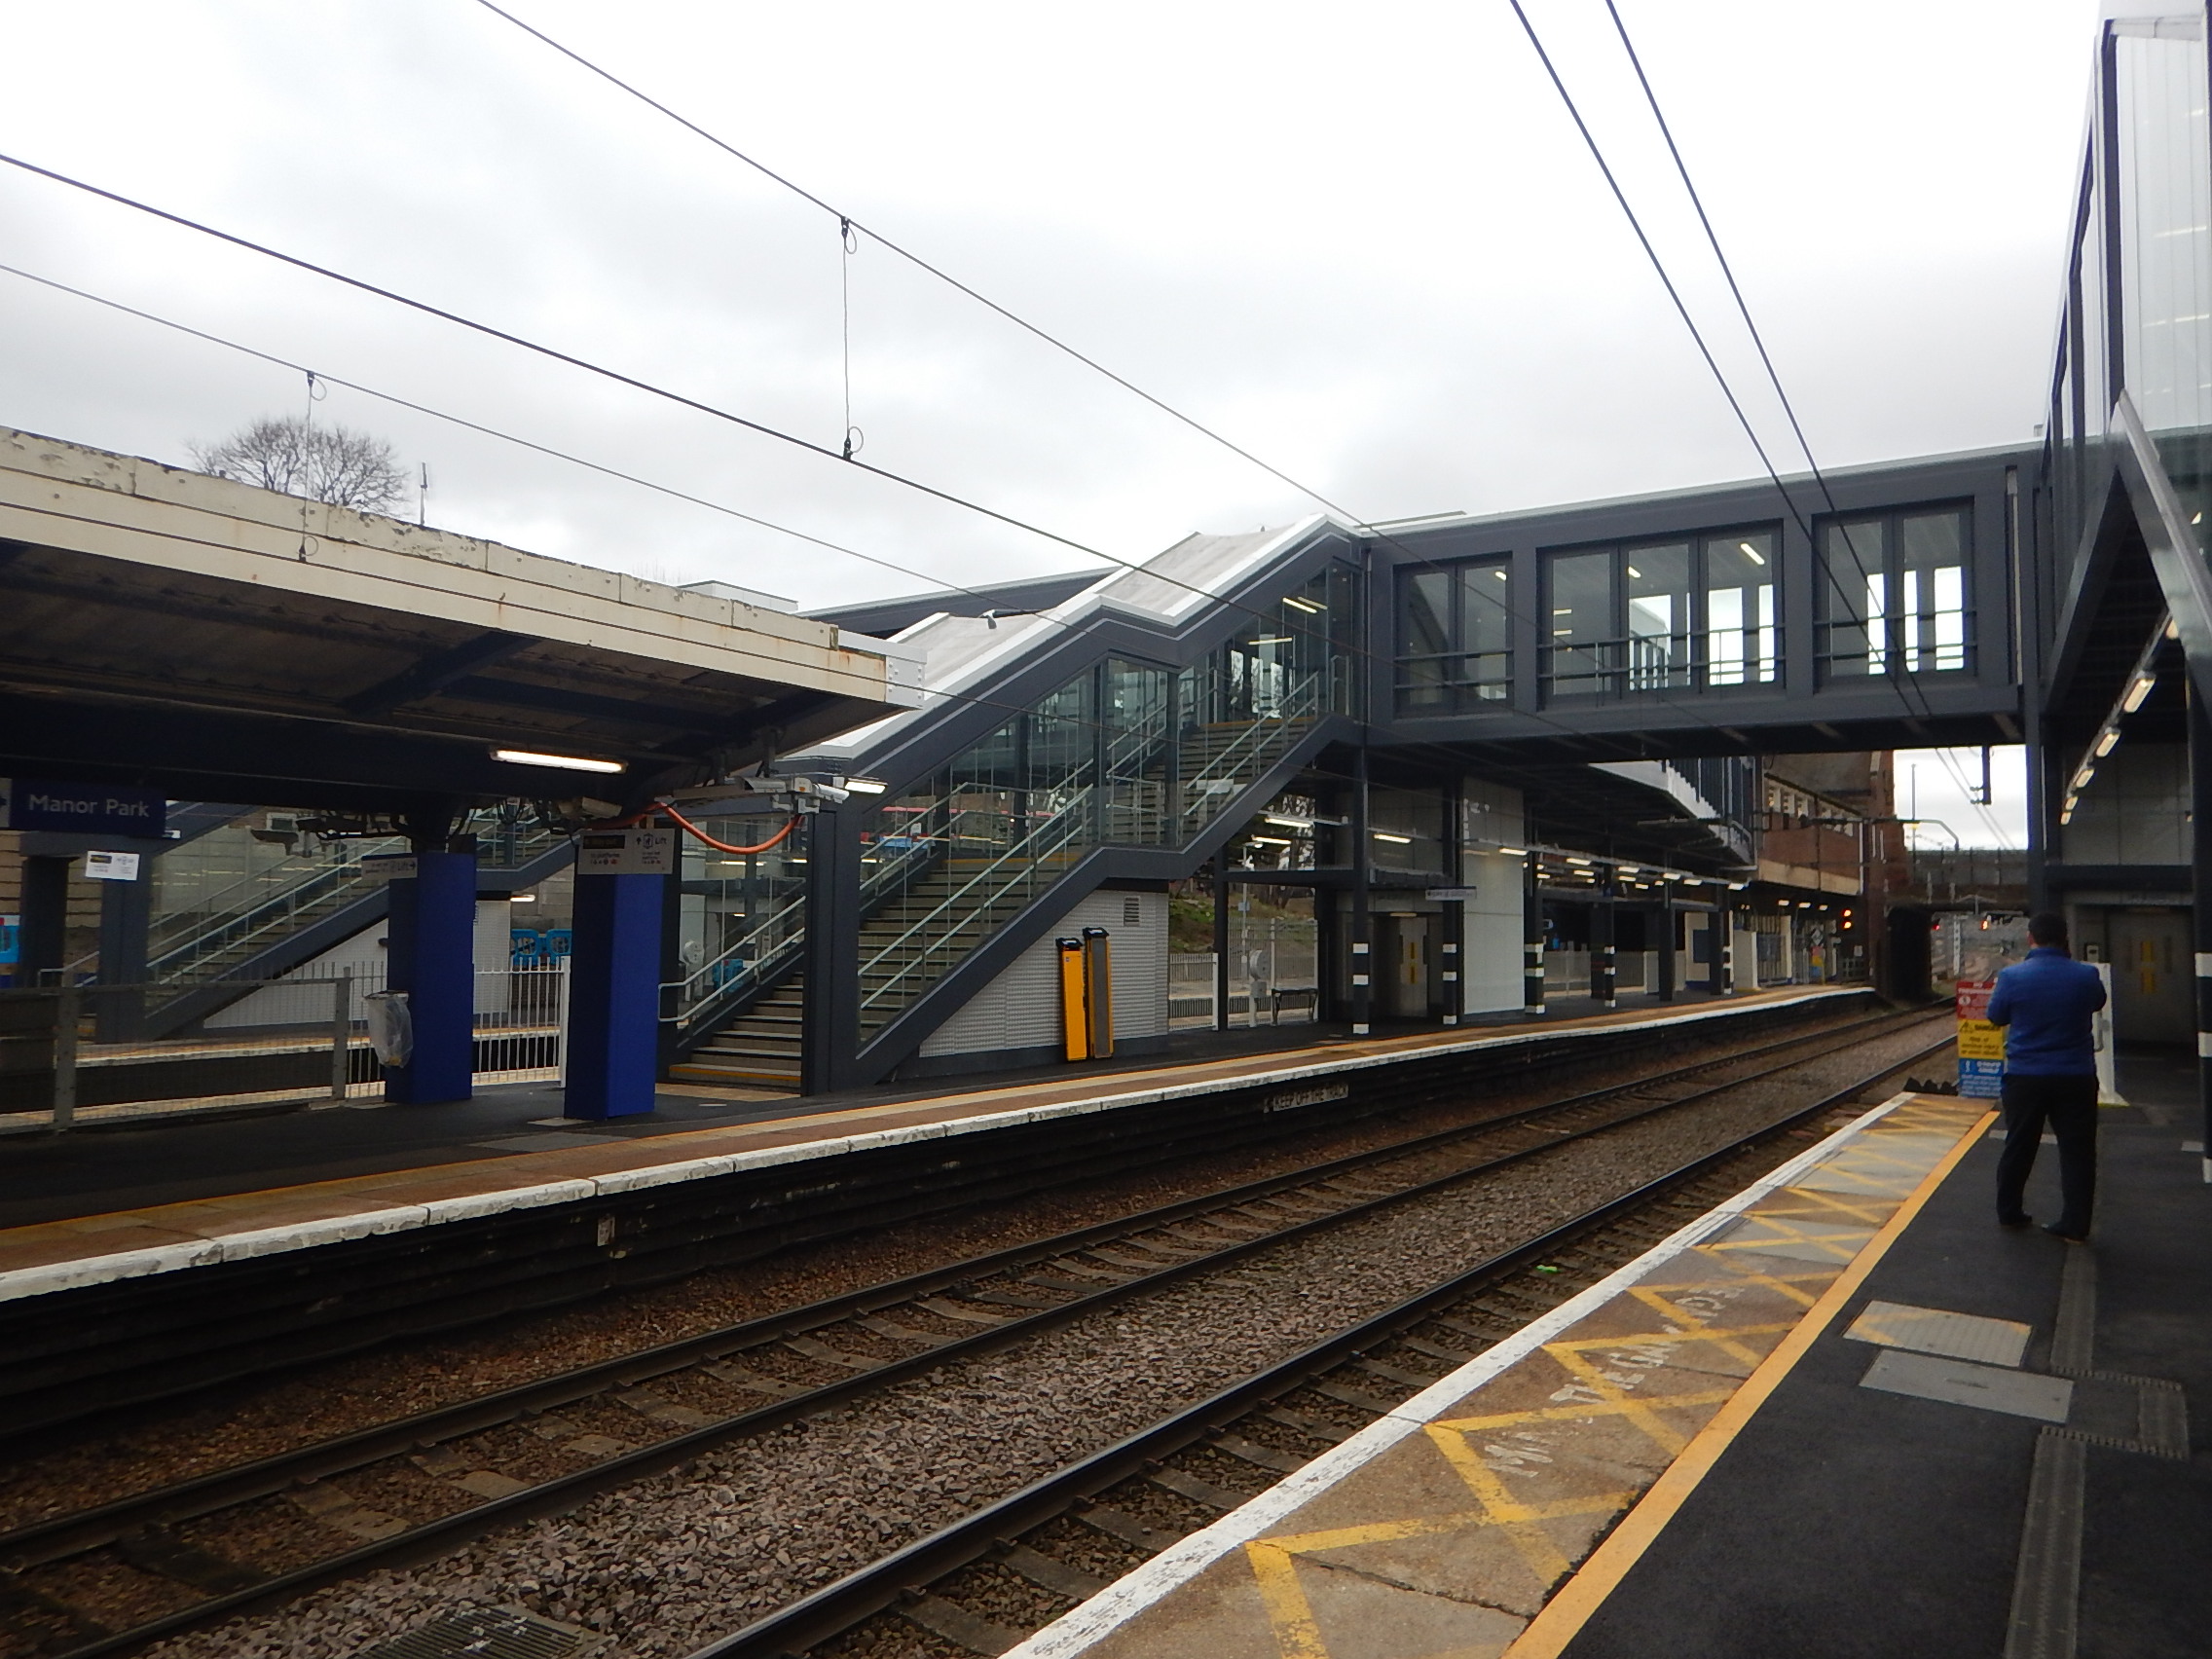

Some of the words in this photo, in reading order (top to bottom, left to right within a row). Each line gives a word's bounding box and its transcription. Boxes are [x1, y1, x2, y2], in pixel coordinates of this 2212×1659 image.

[28, 793, 98, 815] Manor
[105, 797, 150, 818] Park
[654, 836, 667, 845] Lift
[1274, 1092, 1295, 1109] KEEP
[1296, 1089, 1309, 1106] OFF
